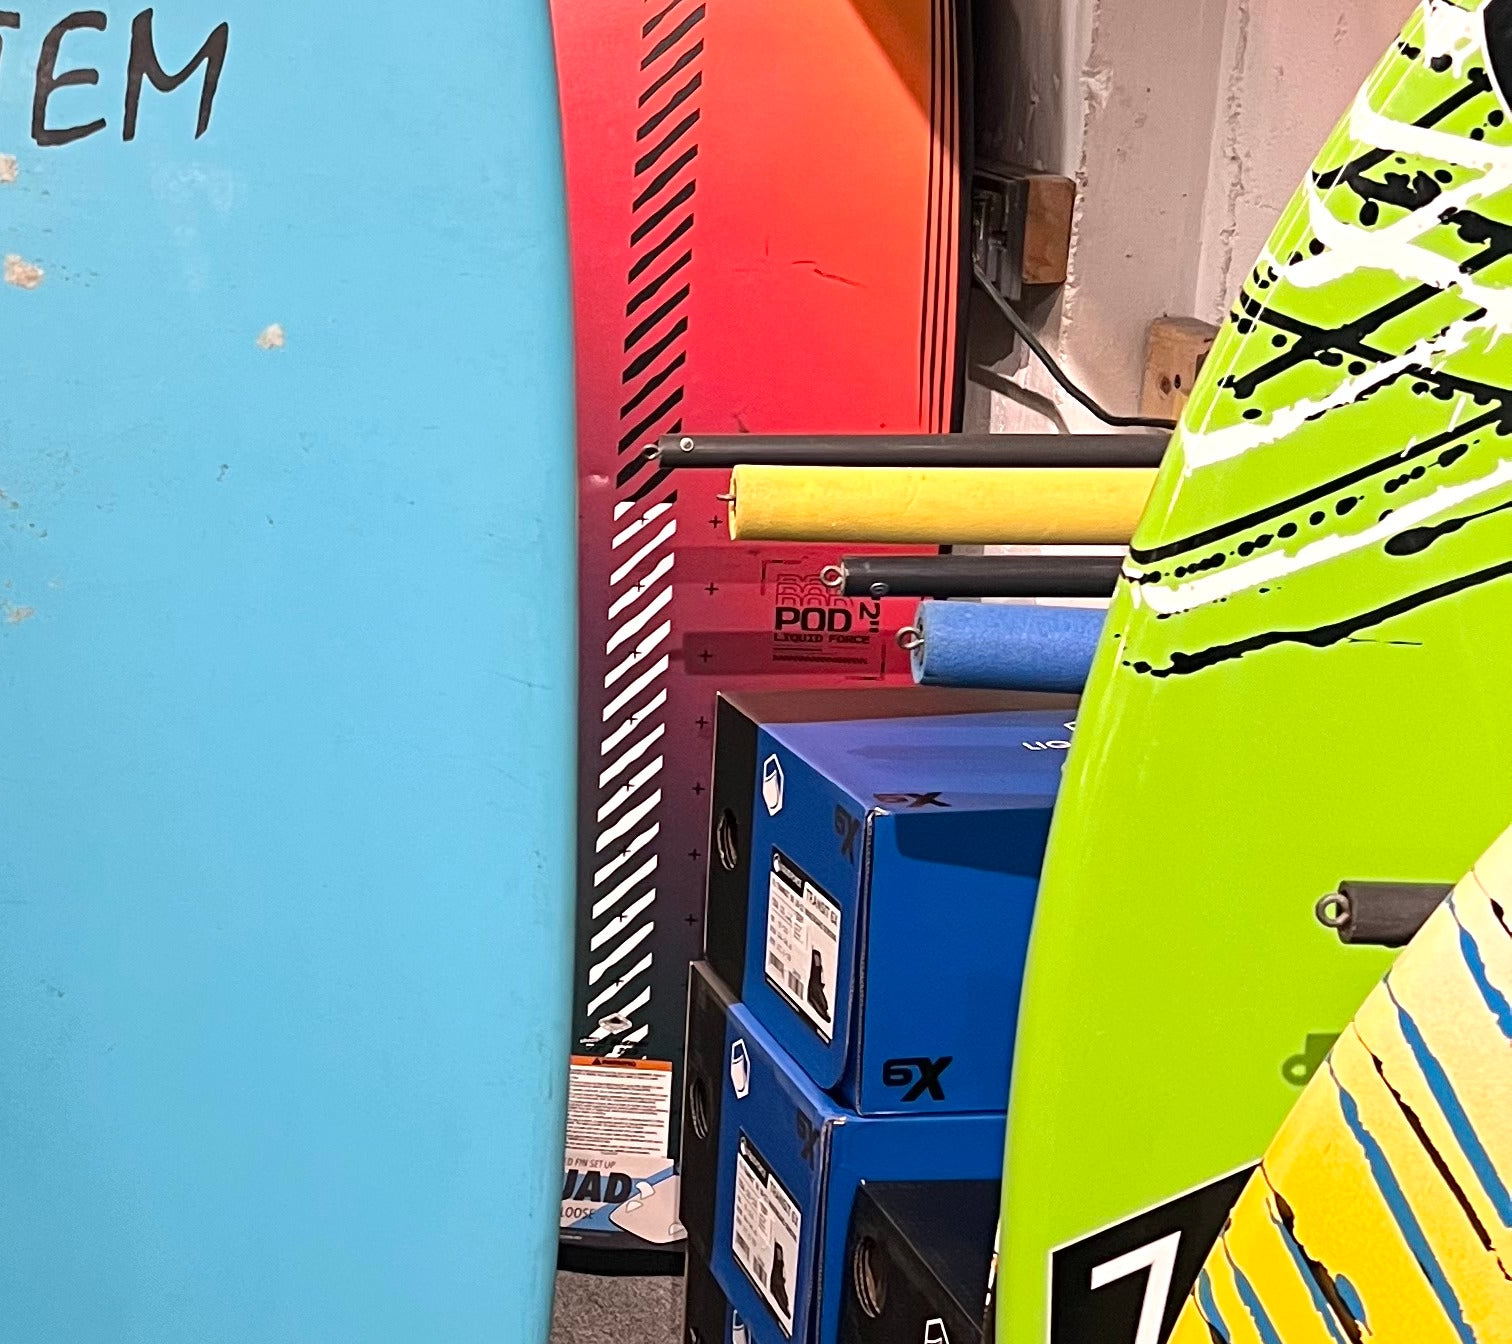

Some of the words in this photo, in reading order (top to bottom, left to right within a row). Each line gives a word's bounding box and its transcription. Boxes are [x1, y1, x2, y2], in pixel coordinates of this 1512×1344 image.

[775, 607, 852, 633] POD
[773, 633, 823, 643] LIQUID
[828, 635, 870, 645] FORCE
[883, 1056, 953, 1102] 6X
[562, 1169, 632, 1204] UAD
